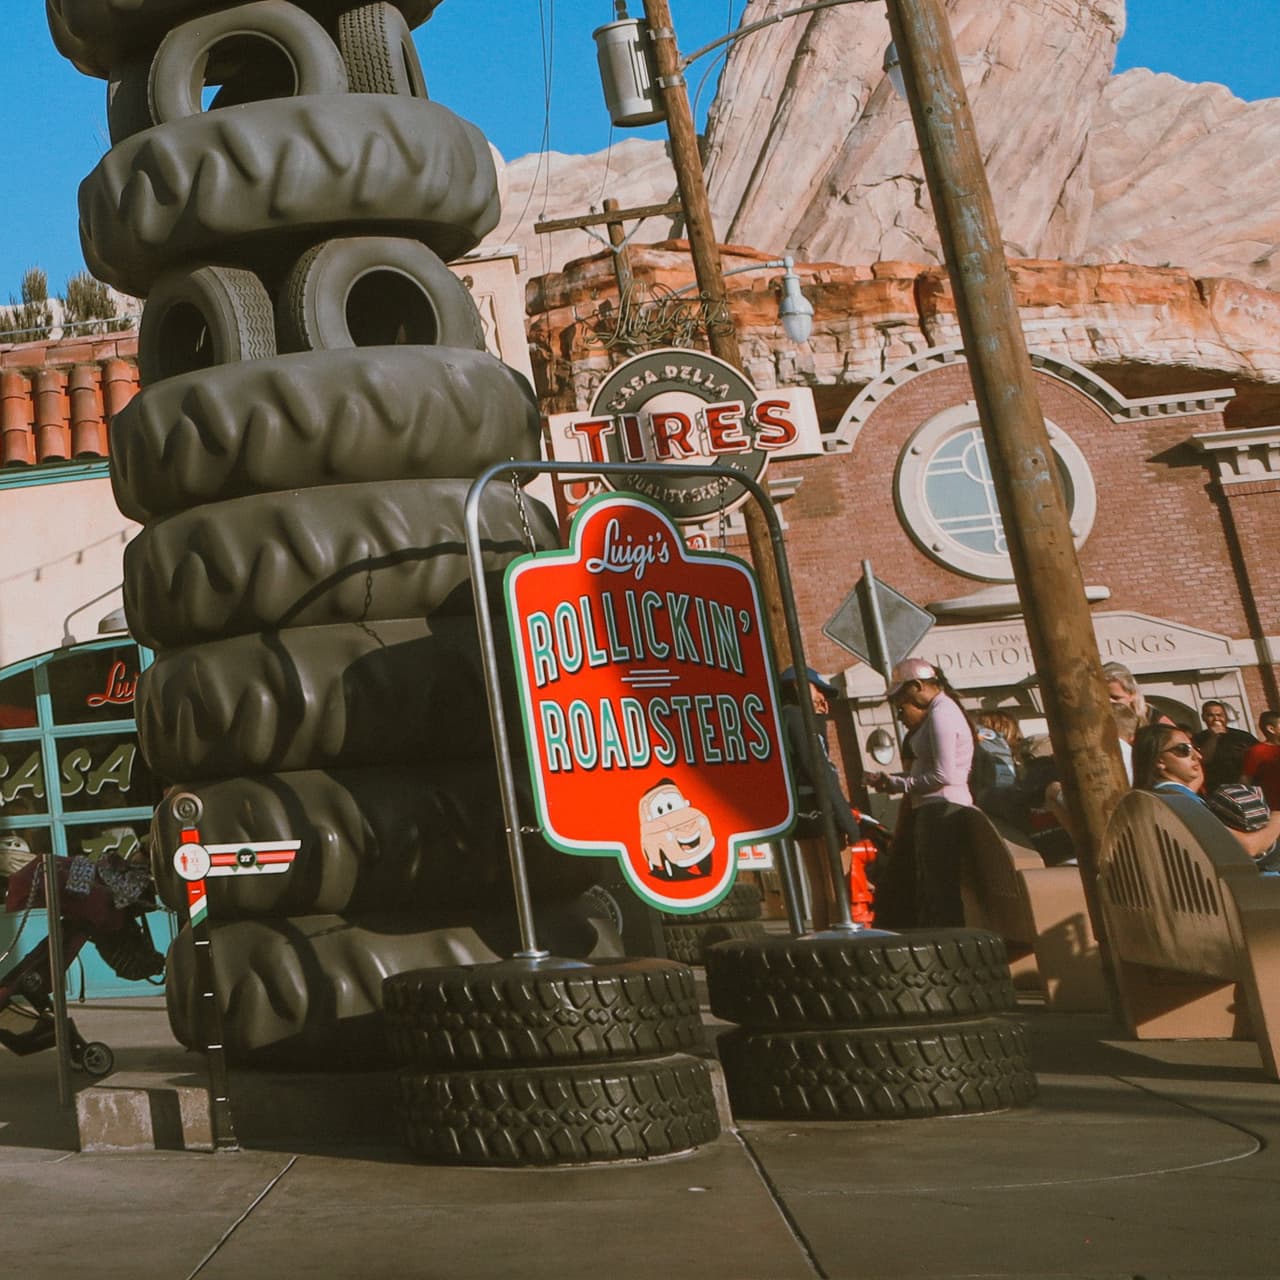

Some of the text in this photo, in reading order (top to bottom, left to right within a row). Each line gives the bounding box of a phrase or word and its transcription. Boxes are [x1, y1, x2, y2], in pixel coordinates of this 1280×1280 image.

[611, 364, 731, 410] CASA DELLA
[570, 399, 800, 464] TIRES
[585, 518, 671, 581] Luigi's
[526, 589, 751, 688] ROLLICKIN'
[990, 632, 1024, 647] TOW
[539, 693, 771, 772] ROADSTERS
